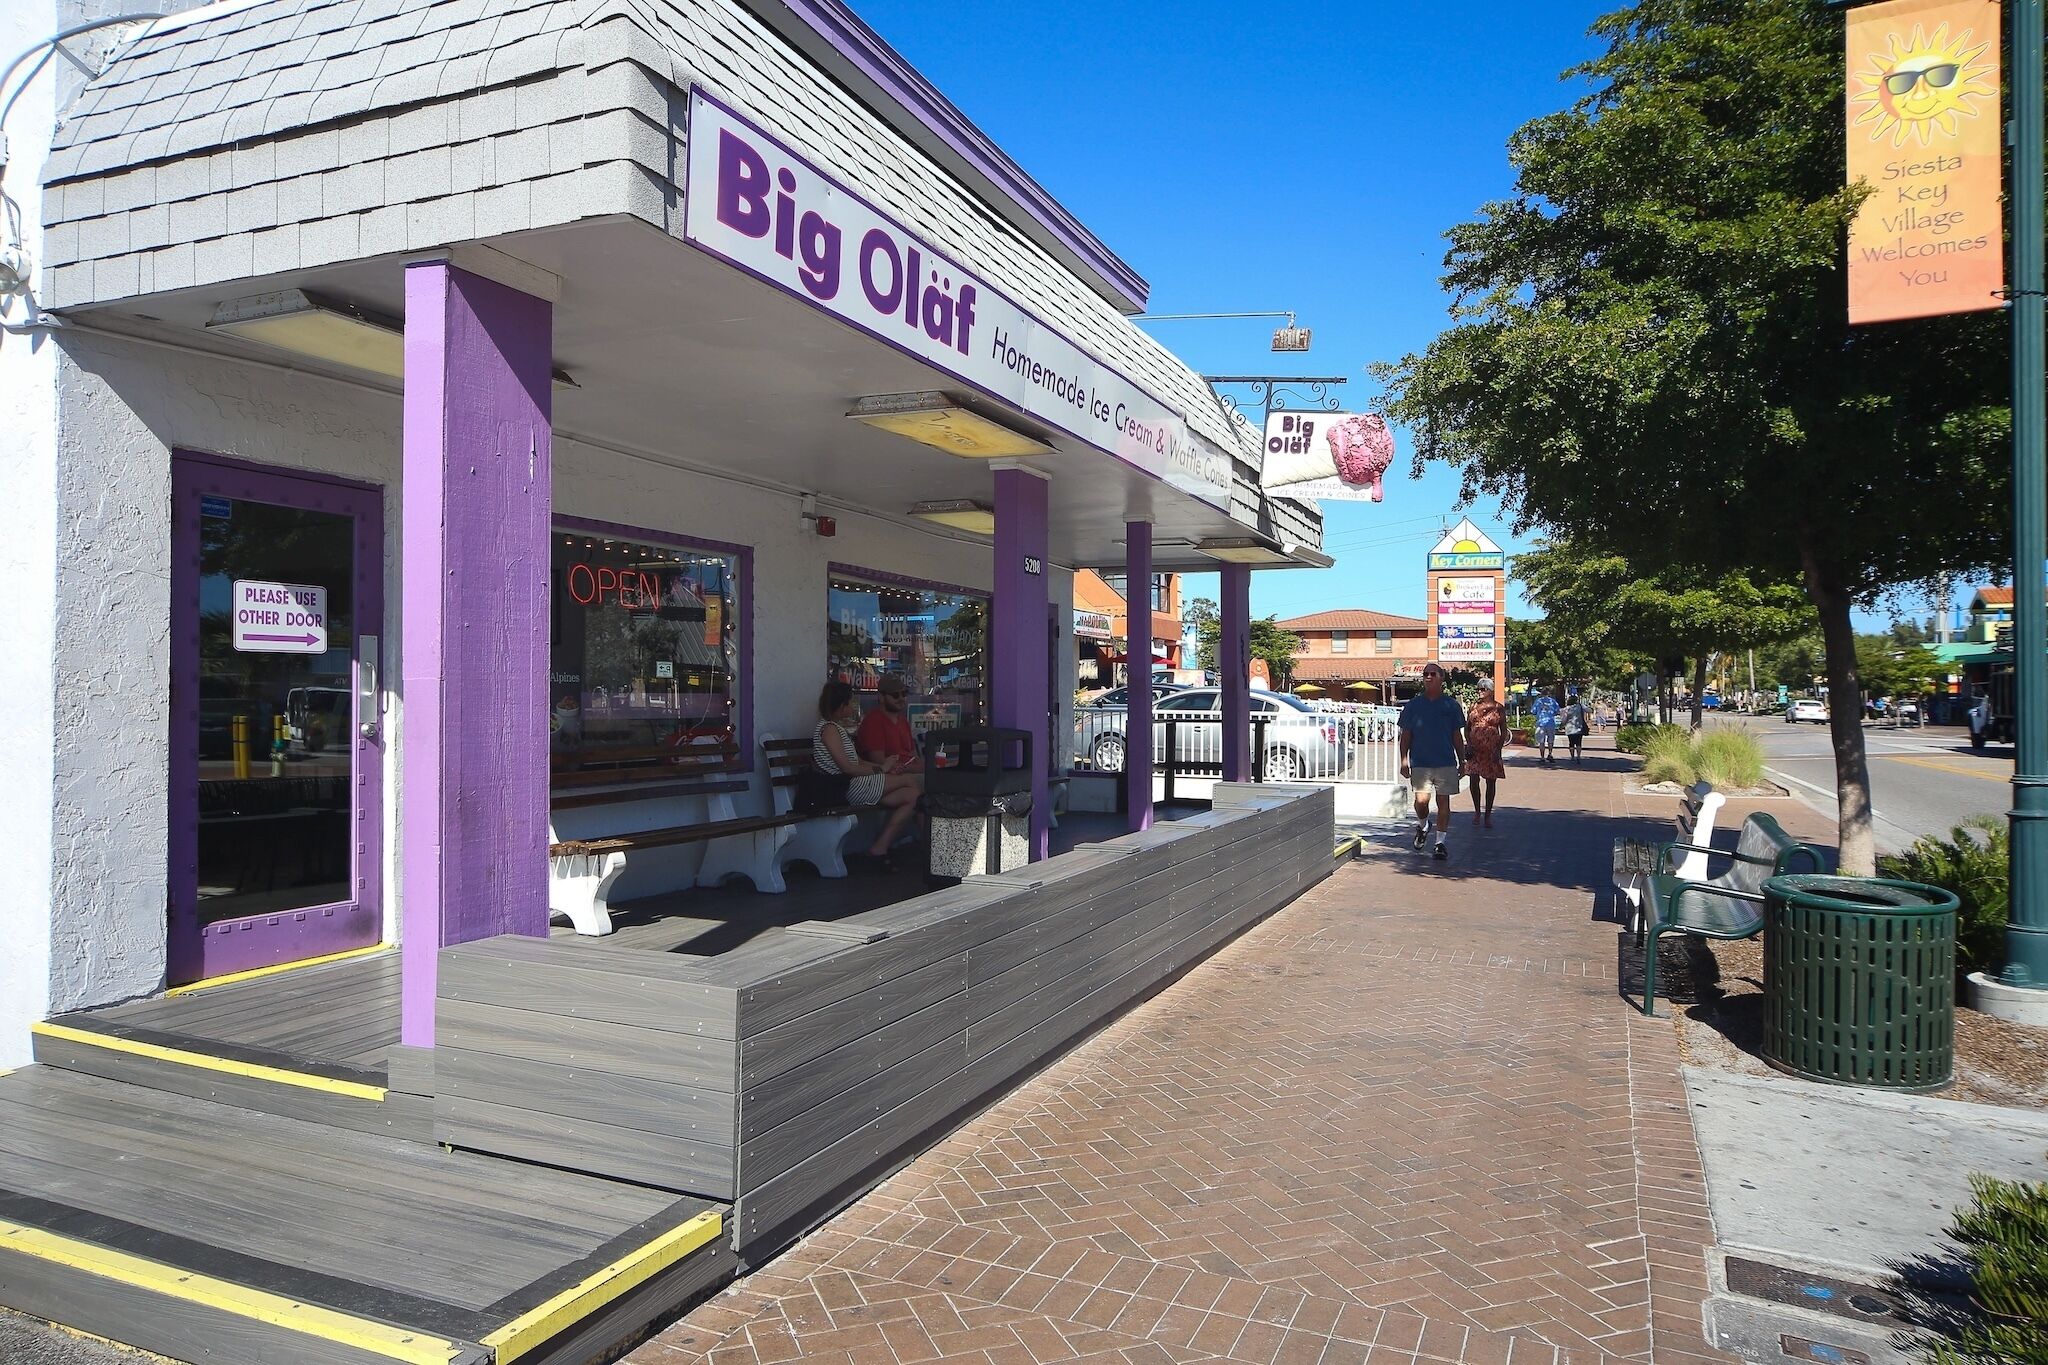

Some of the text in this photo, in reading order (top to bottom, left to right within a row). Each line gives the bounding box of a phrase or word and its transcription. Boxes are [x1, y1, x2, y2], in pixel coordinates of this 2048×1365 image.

[1882, 155, 1962, 180] Siesta
[1898, 184, 1948, 208] Key
[1882, 207, 1965, 234] Village
[1862, 235, 1988, 263] Welcomes
[1899, 269, 1948, 288] You
[716, 126, 1230, 490] Big Oläf Homemade Ice Cream & Waffle Cones
[1282, 415, 1314, 438] Big
[1268, 436, 1311, 455] Oläf
[1294, 482, 1345, 490] HOMEMADE
[1336, 491, 1366, 499] CONES
[1025, 557, 1041, 574] 5208
[1431, 555, 1501, 568] Key Corners
[245, 587, 317, 607] PLEASE USE
[569, 564, 660, 611] OPEN
[238, 609, 323, 628] OTHER DOOR
[841, 608, 867, 643] Big
